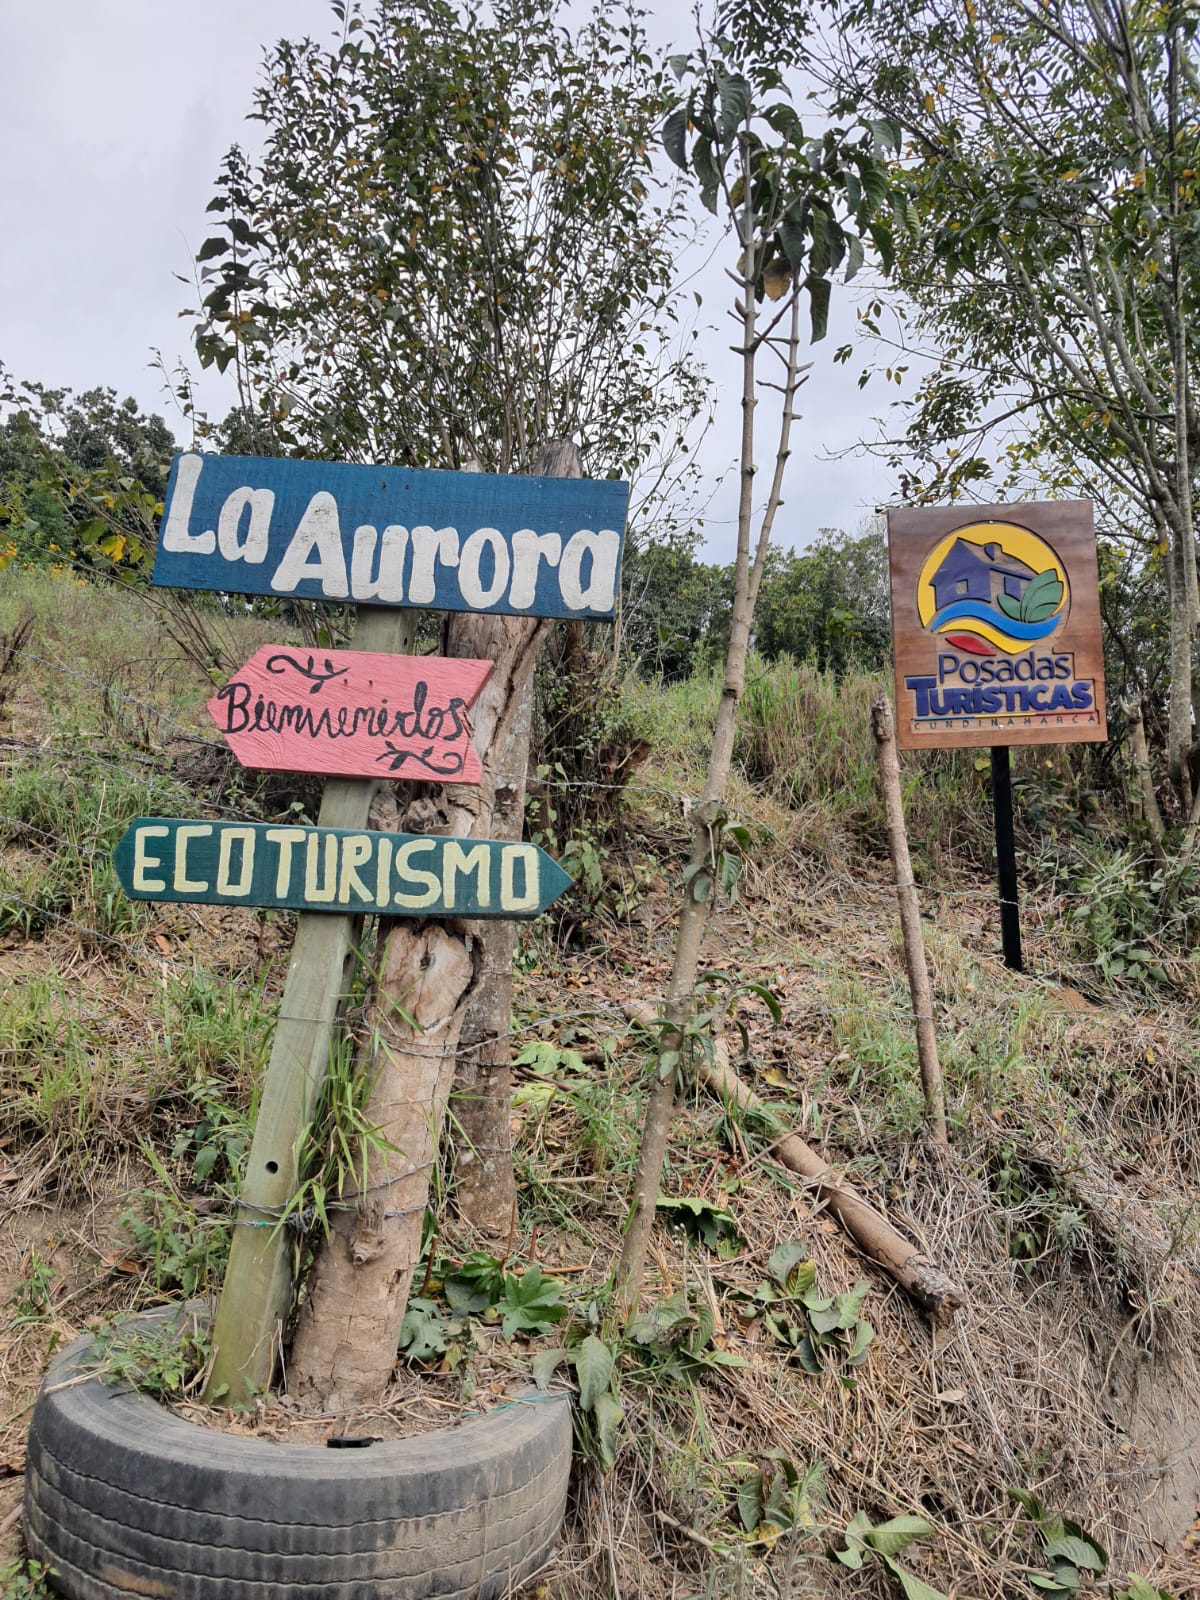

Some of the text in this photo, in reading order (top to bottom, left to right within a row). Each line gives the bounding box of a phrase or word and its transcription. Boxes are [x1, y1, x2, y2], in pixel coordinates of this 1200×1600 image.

[162, 453, 620, 612] La Aurora
[939, 651, 1071, 684] Posadas
[217, 681, 465, 741] Bienvenidos
[914, 716, 1095, 730] CUNDINAMARCA
